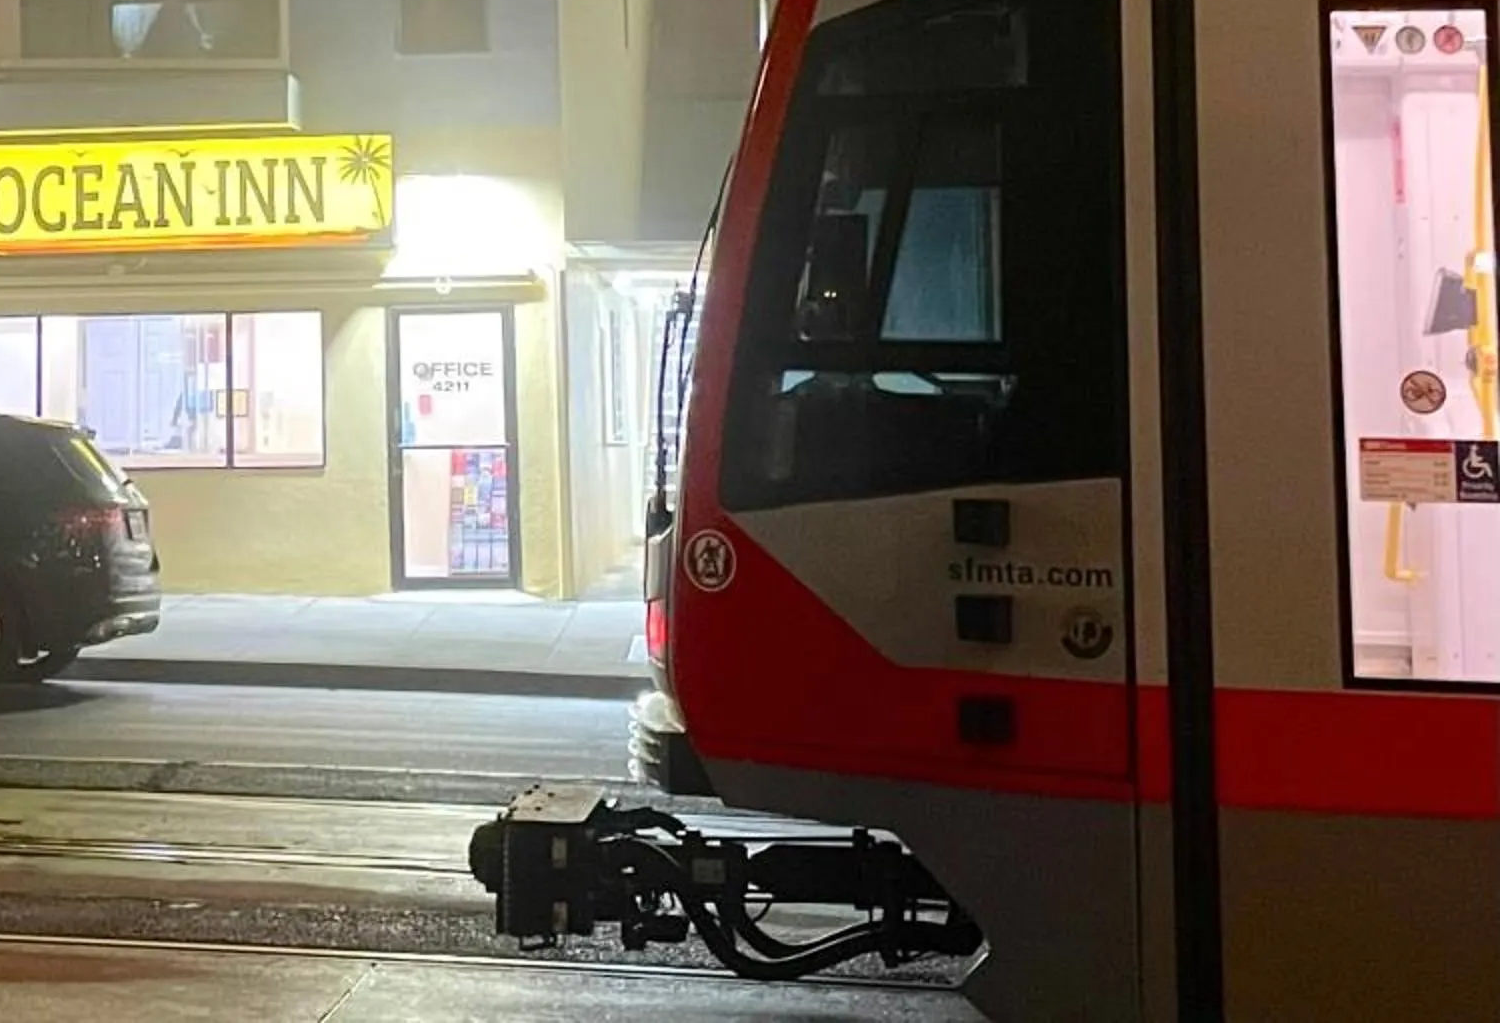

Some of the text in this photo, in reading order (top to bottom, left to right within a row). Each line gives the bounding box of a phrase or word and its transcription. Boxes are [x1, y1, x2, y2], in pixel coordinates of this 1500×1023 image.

[214, 156, 327, 226] INN
[412, 361, 494, 379] OFFICE
[432, 380, 470, 393] 4211
[947, 556, 1114, 588] sfmta.com
